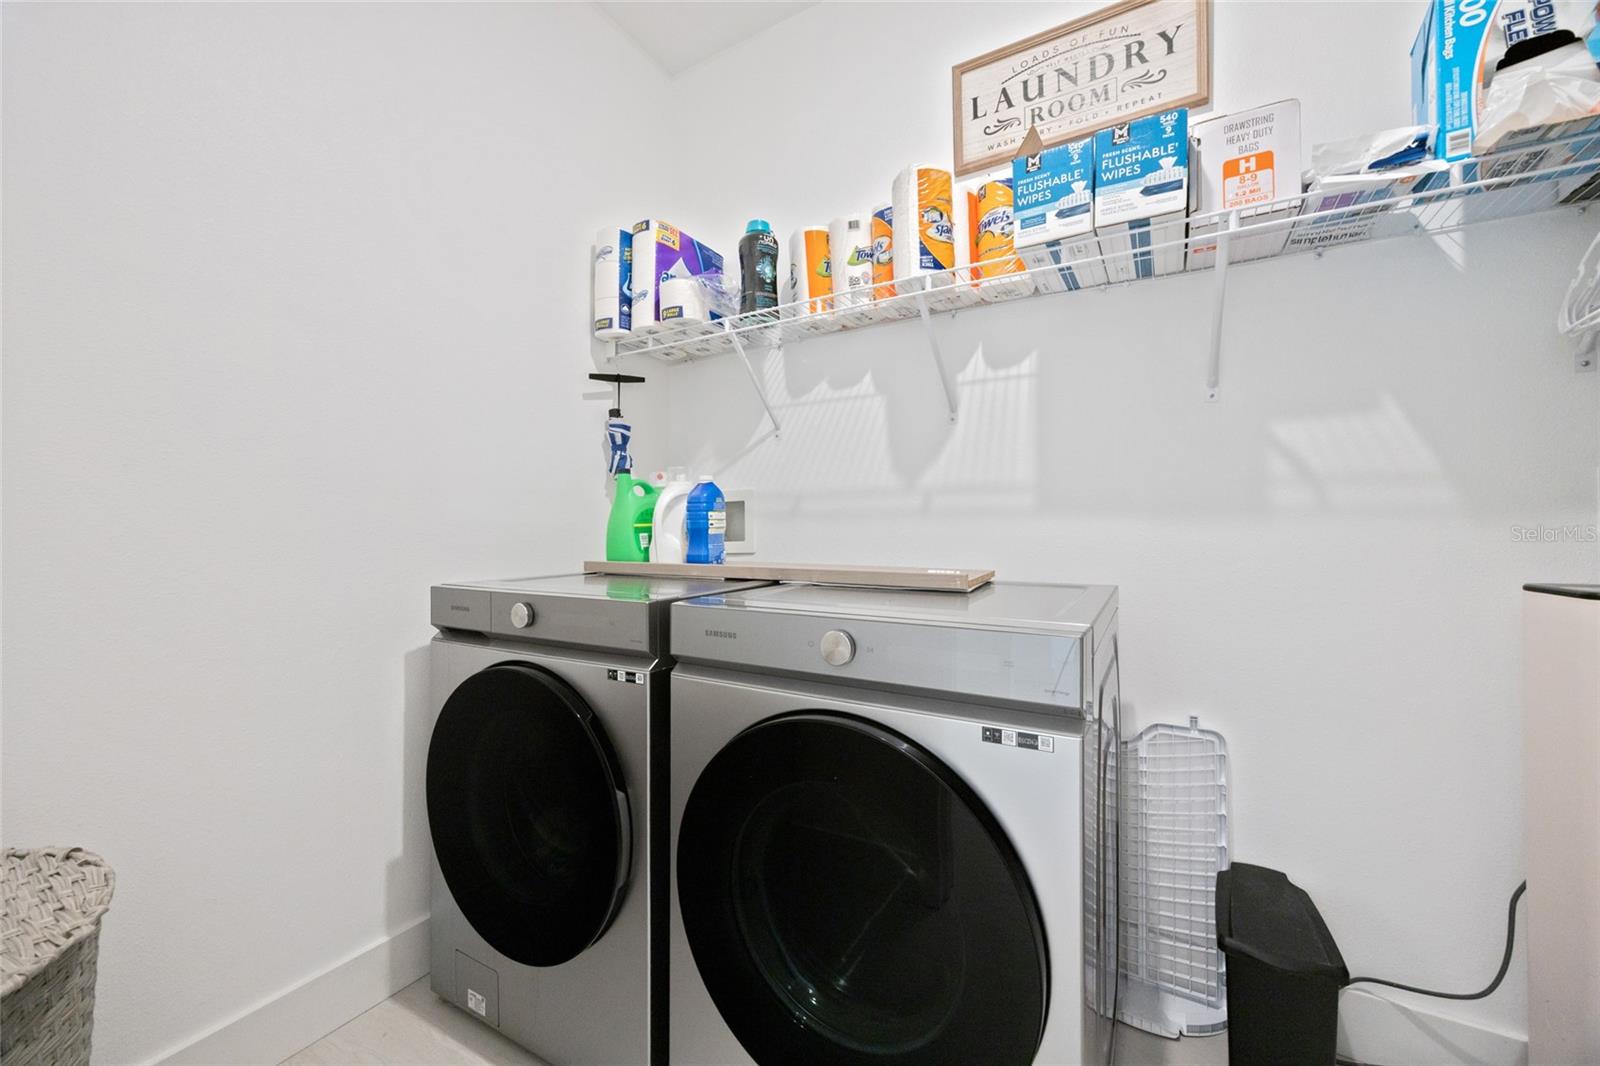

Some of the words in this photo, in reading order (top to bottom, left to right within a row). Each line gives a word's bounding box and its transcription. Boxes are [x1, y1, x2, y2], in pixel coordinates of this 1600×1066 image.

[1503, 9, 1529, 48] FLE
[1011, 43, 1060, 73] LOADS
[1069, 34, 1088, 47] OF
[1099, 25, 1129, 38] FUN
[1441, 37, 1457, 60] Bags
[970, 23, 1185, 121] LAUNDRY
[1029, 83, 1111, 125] ROOM
[987, 137, 1017, 151] WASH
[1039, 127, 1053, 136] RY
[1068, 113, 1099, 126] FOLD
[1116, 92, 1163, 111] REPEAT
[1160, 112, 1178, 123] 540
[1223, 113, 1274, 135] DRAWSTRING
[1226, 131, 1251, 145] HEAVY
[1252, 126, 1274, 139] DUTY
[1102, 150, 1120, 159] FRESH
[1121, 145, 1140, 154] SCENT
[1238, 142, 1260, 155] BAGS
[1101, 164, 1141, 182] WIPES
[1239, 155, 1257, 174] H
[1018, 176, 1033, 185] FRESH
[1034, 172, 1051, 180] SCENT
[1239, 173, 1257, 184] 8-9
[1017, 190, 1052, 207] WIPES
[705, 629, 737, 639] SAMSUNG
